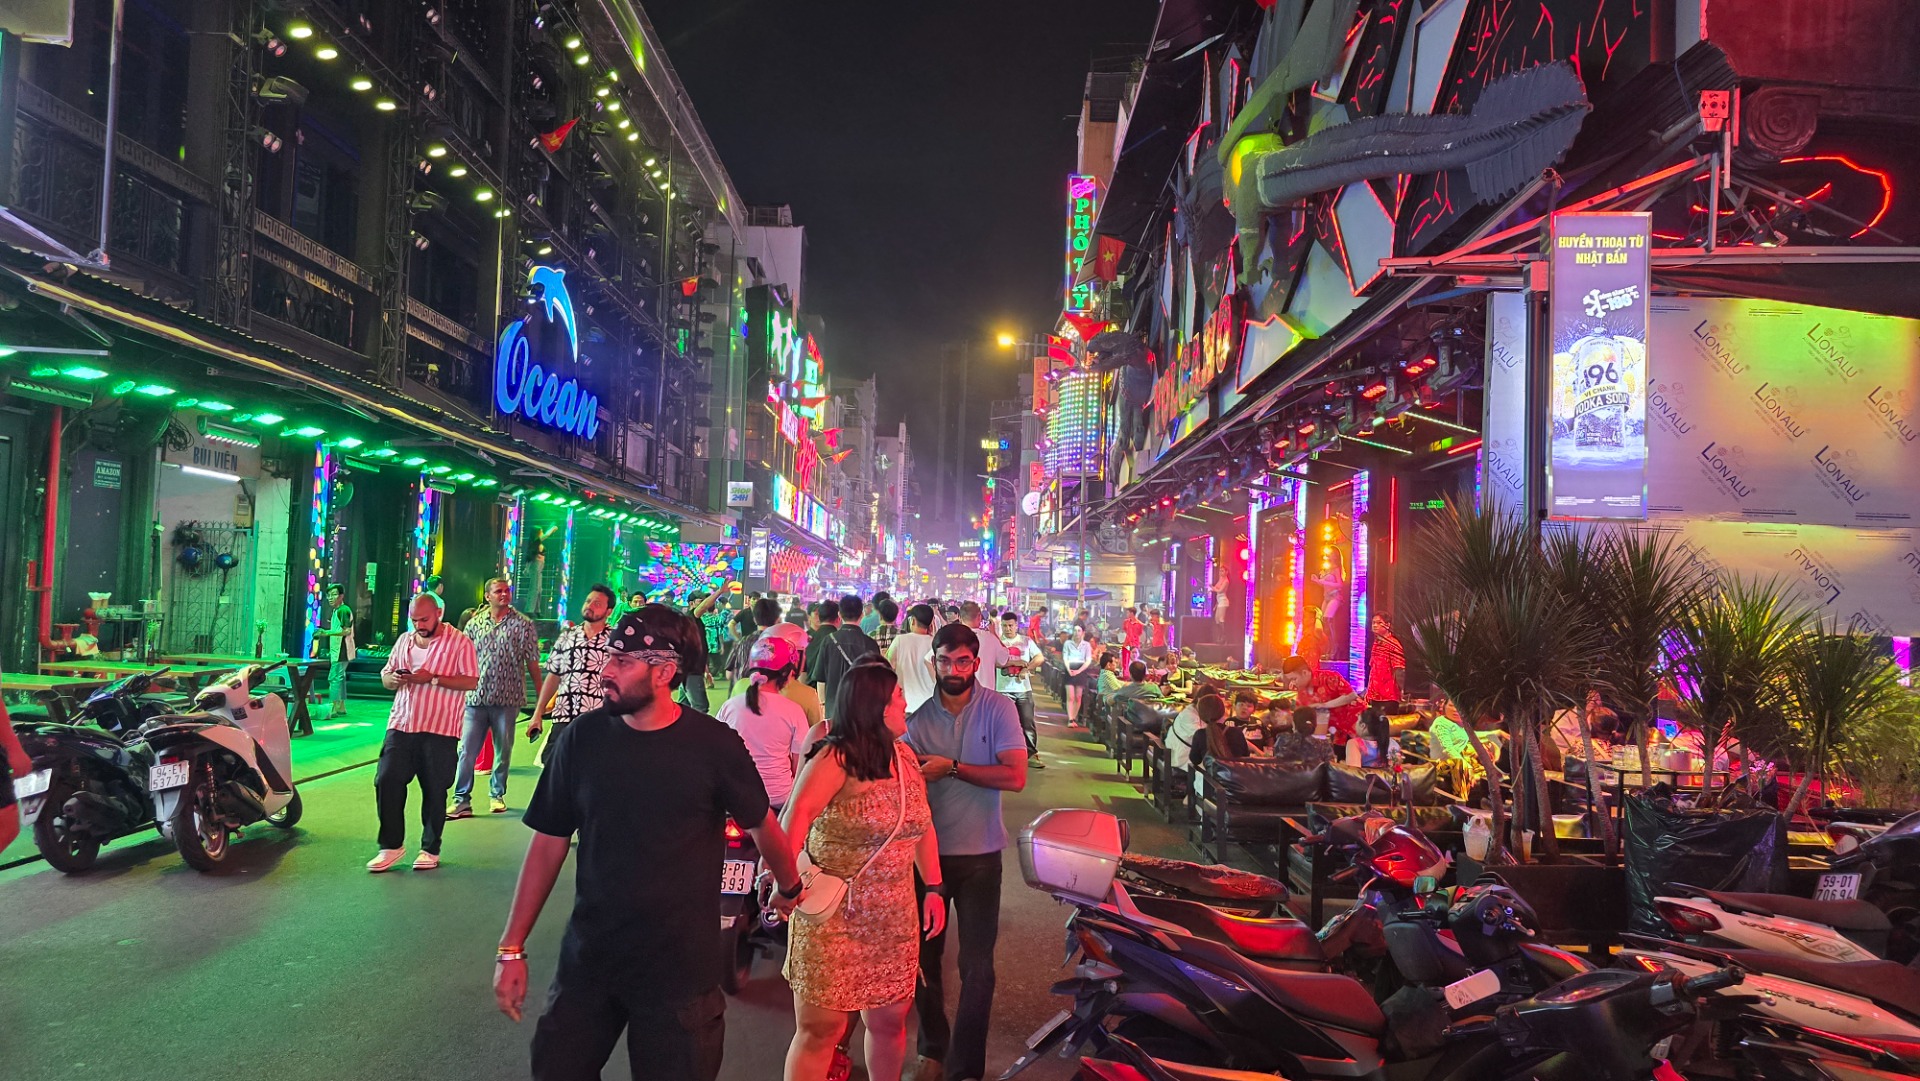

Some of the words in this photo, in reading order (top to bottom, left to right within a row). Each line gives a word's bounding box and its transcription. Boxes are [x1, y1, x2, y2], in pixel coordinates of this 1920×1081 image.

[1073, 198, 1090, 251] PHỐ
[1629, 234, 1644, 248] TỪ
[1575, 250, 1604, 267] NHẬT
[496, 320, 599, 440] Ocean
[193, 445, 211, 466] BÙI
[156, 764, 183, 777] 94-E1
[152, 774, 187, 789] 537.76
